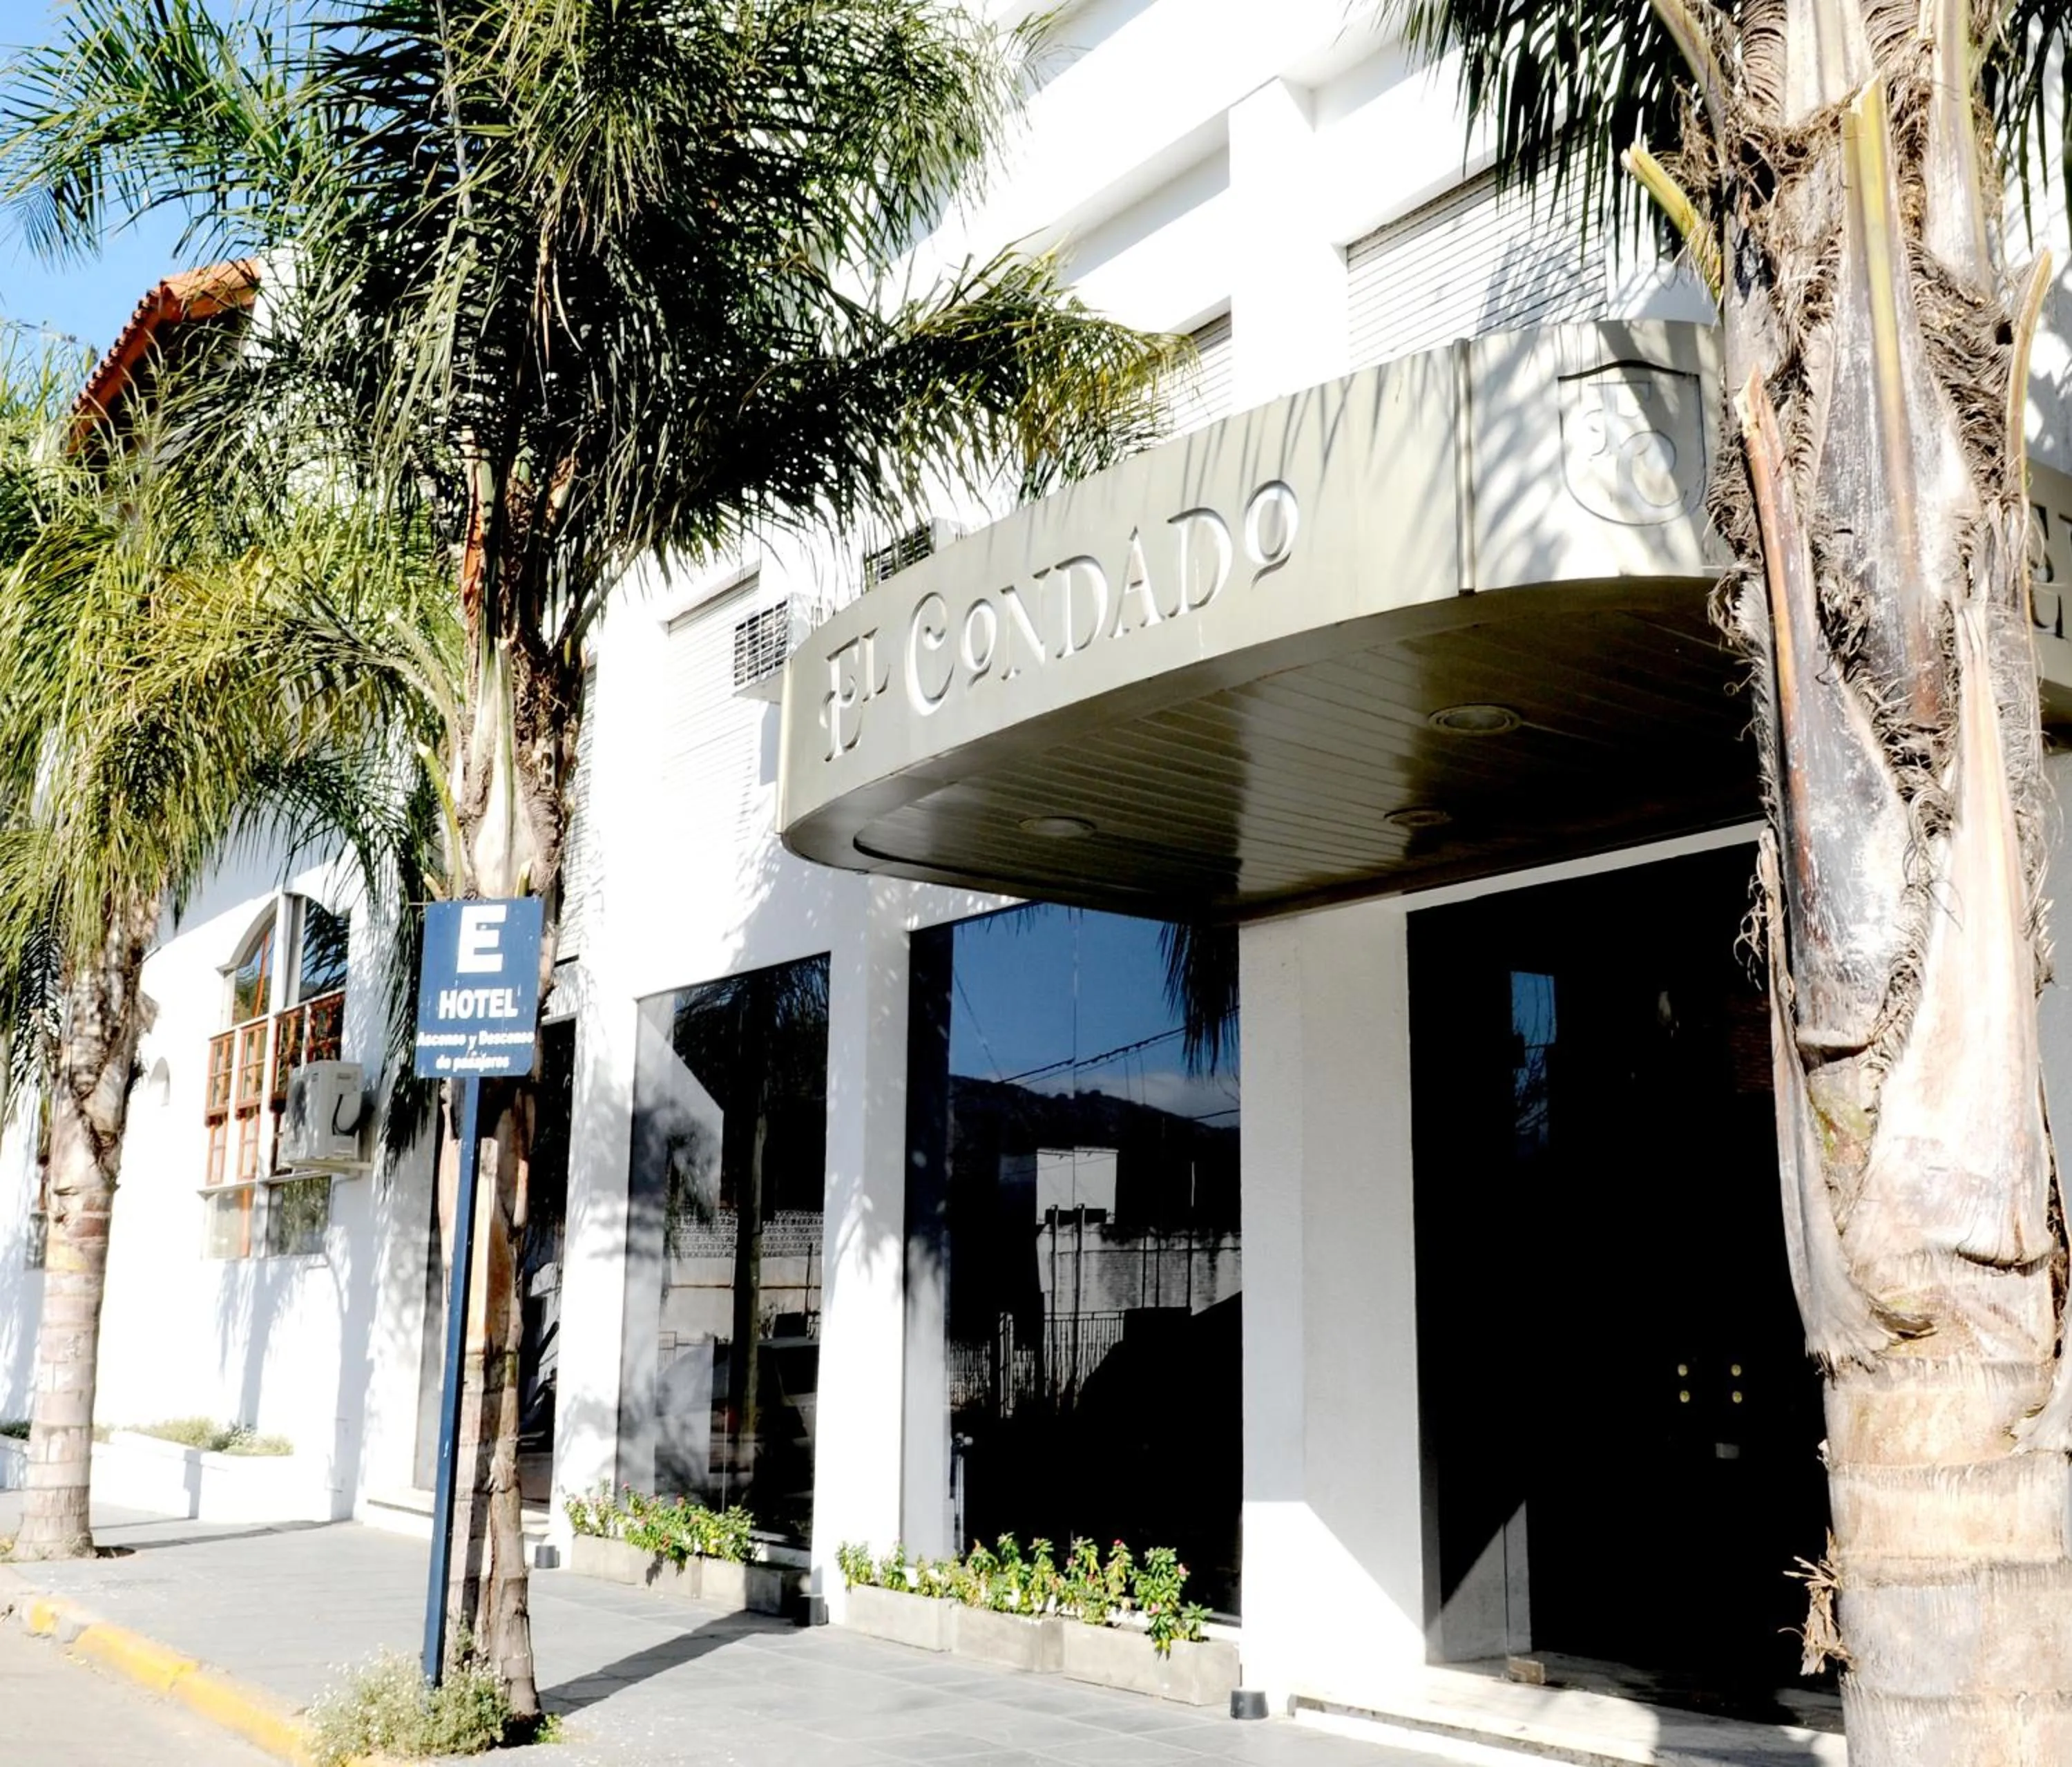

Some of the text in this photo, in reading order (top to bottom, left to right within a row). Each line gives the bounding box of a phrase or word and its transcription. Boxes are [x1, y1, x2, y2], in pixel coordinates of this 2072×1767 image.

[818, 479, 1298, 762] EL CONDADO
[457, 904, 507, 973] E
[439, 988, 517, 1019] HOTEL
